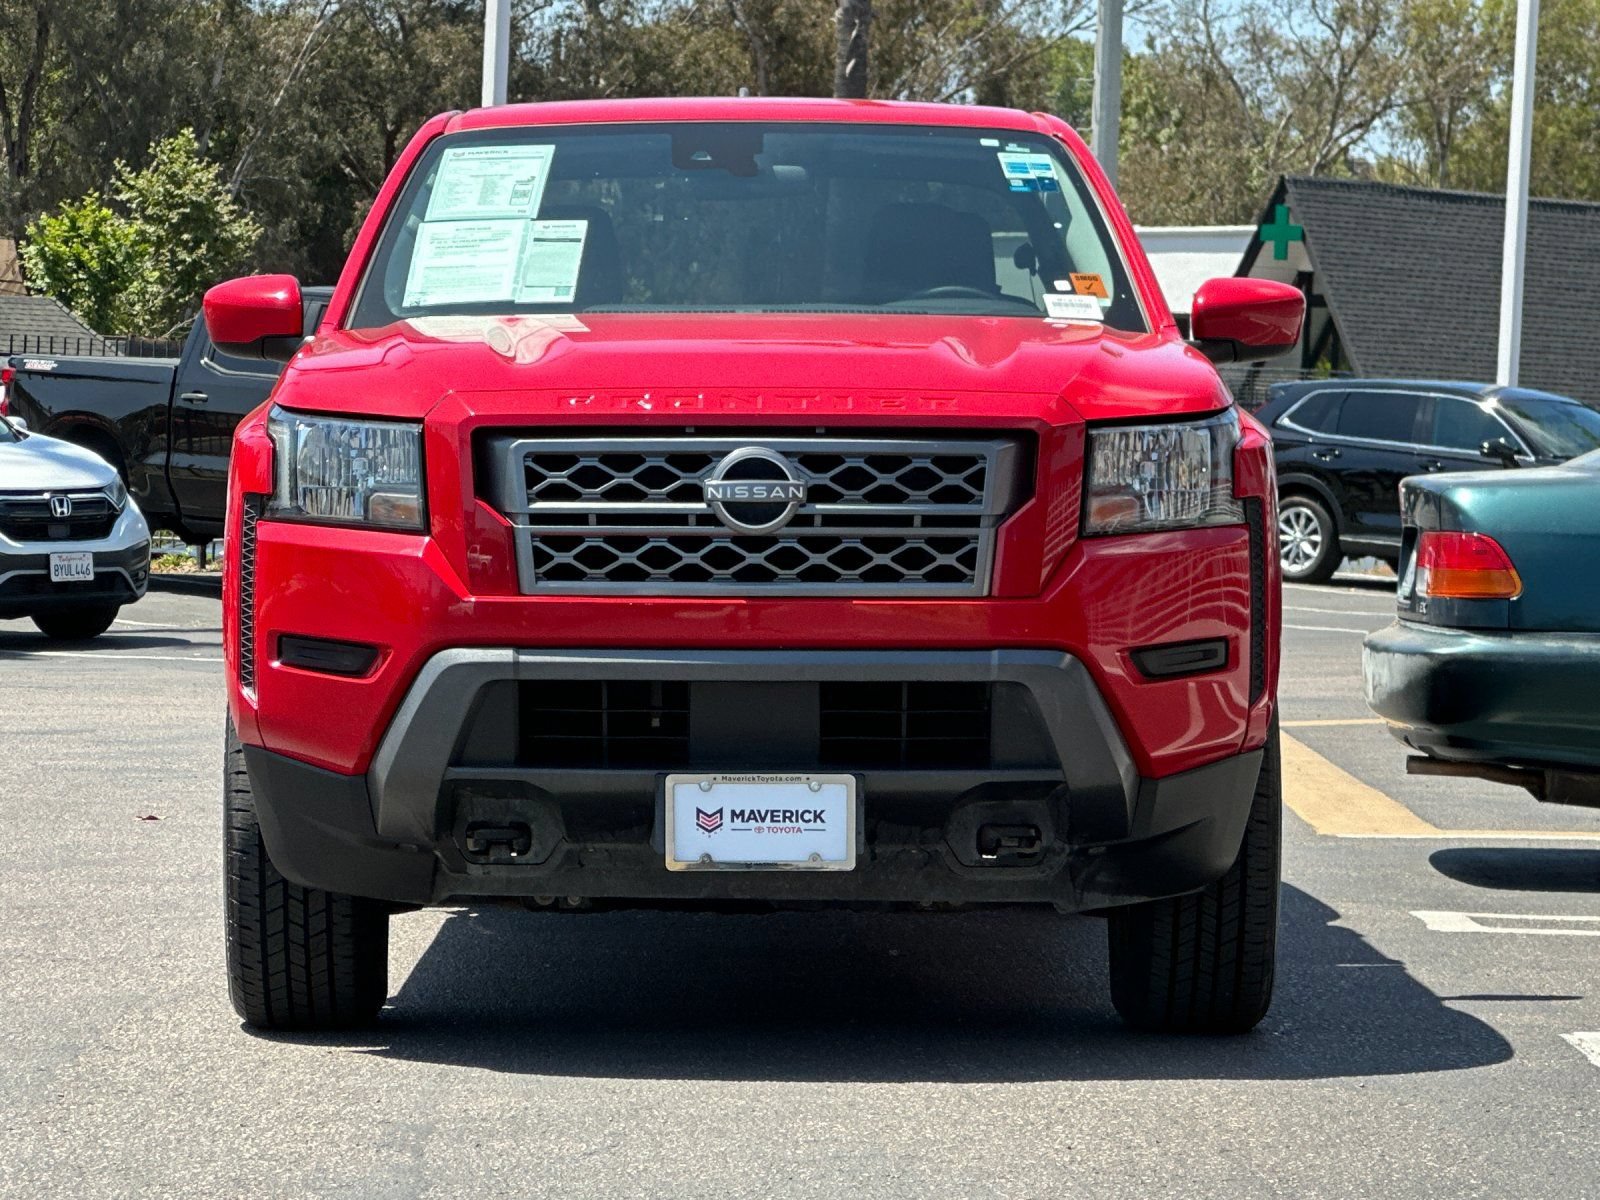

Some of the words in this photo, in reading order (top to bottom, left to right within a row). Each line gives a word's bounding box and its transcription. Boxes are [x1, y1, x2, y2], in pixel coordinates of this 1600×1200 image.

[707, 486, 803, 499] NISSAN
[53, 563, 91, 577] 8YUL446
[721, 775, 802, 783] MaverickToyota.com
[730, 809, 826, 824] MAVERICK
[766, 826, 803, 834] TOYOTA
